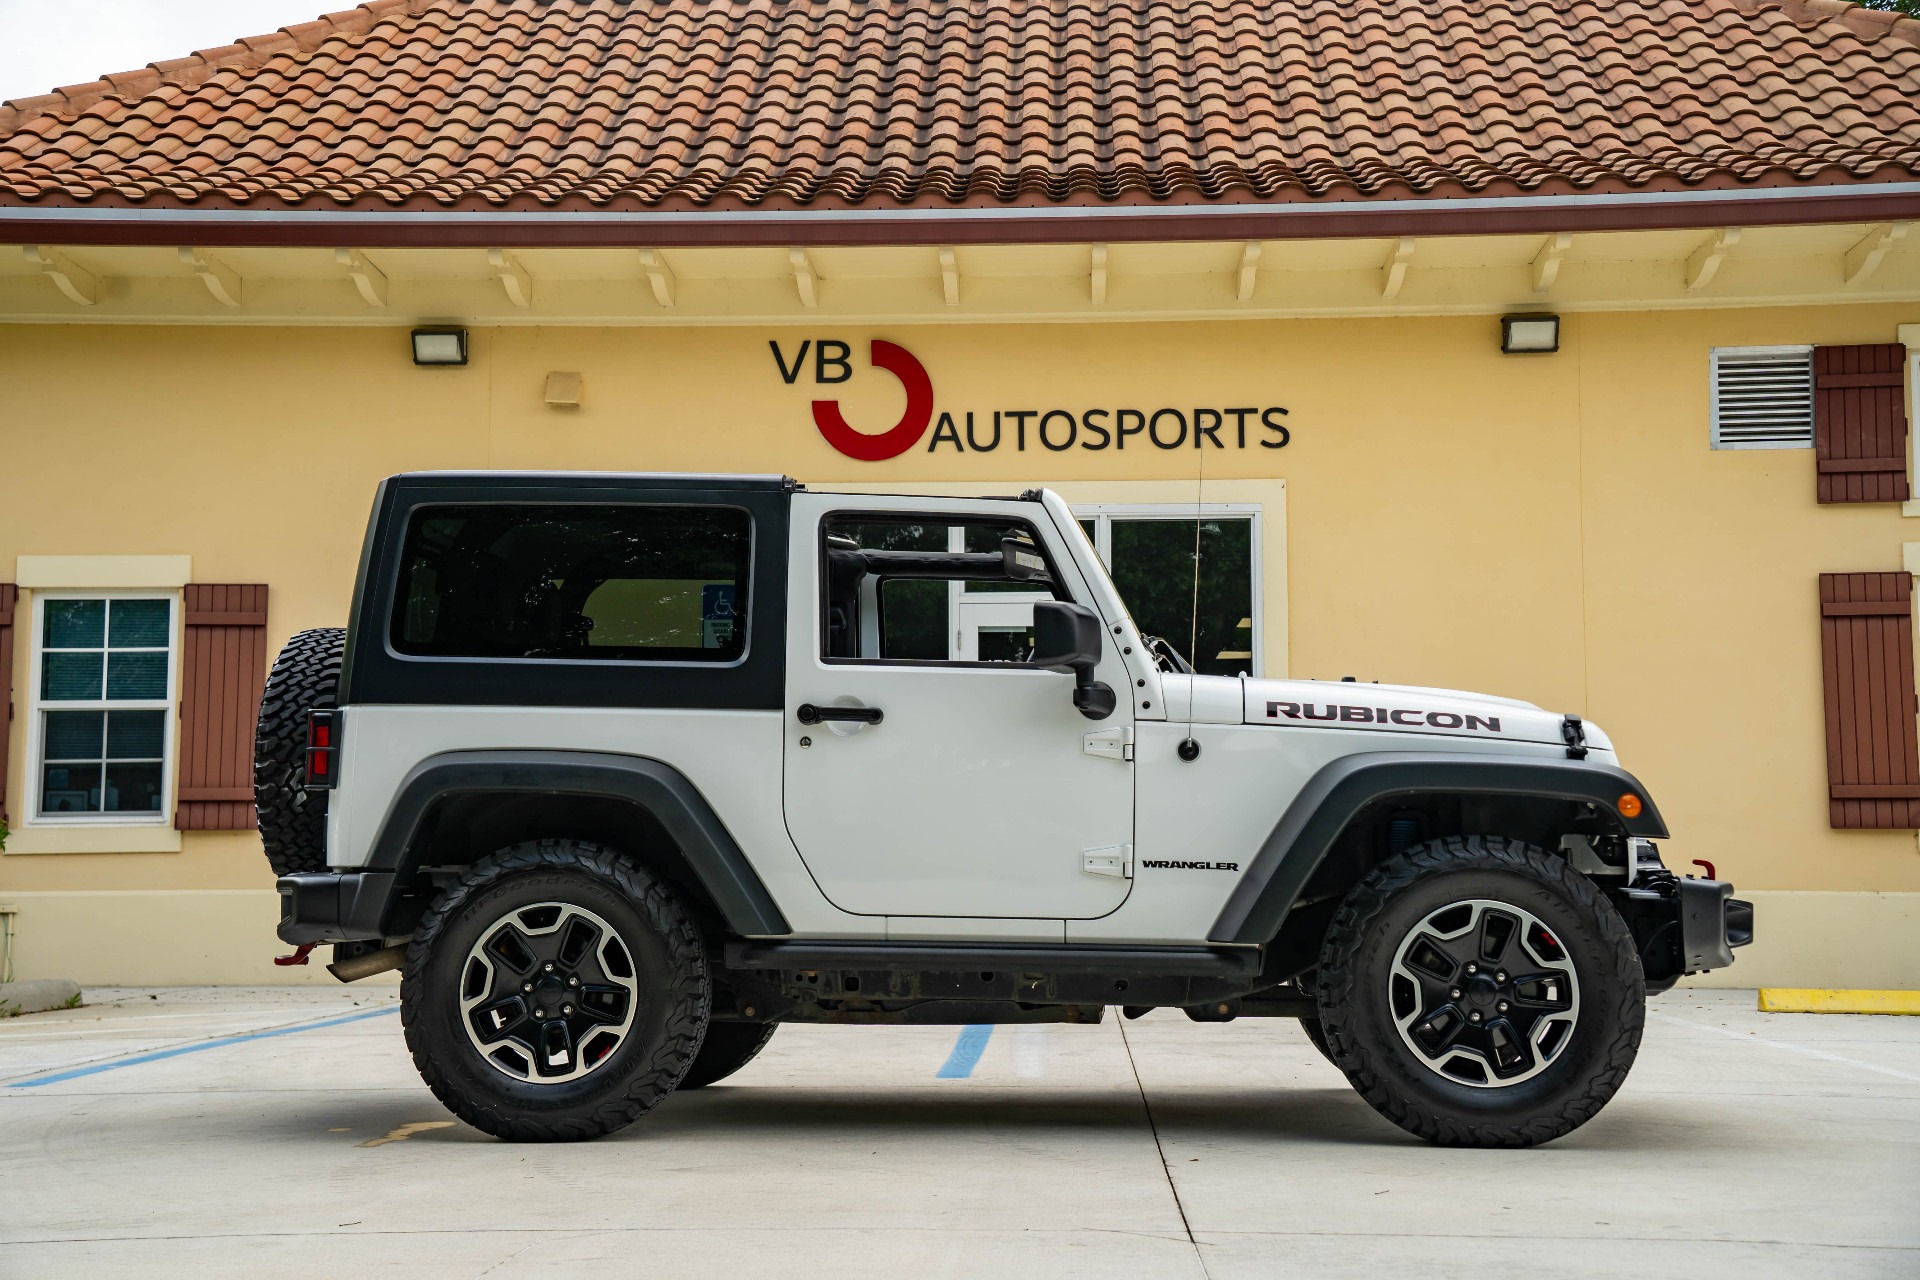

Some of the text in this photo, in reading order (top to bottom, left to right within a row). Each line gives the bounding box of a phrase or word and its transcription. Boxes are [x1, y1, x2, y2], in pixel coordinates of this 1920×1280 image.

[769, 340, 853, 384] VB
[927, 407, 1291, 452] AUTOSPORTS
[1266, 701, 1502, 732] RUBICON
[1142, 860, 1239, 871] WRANGLER
